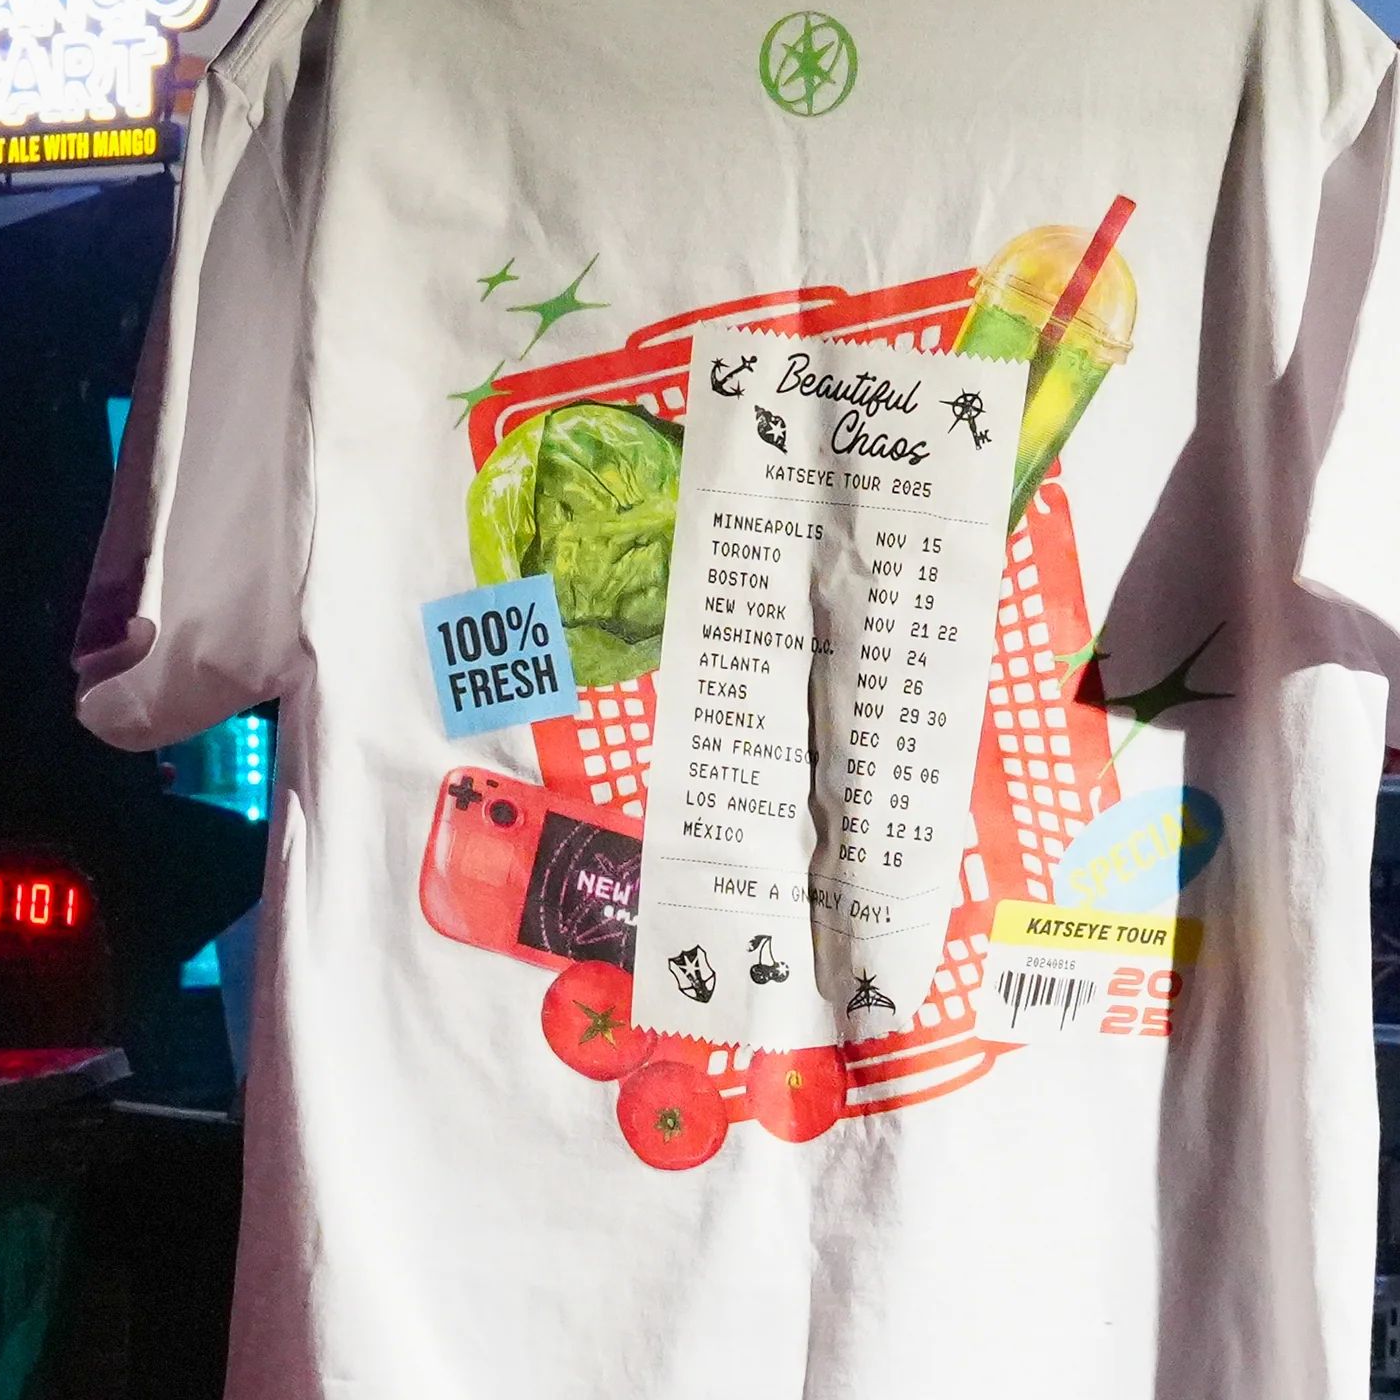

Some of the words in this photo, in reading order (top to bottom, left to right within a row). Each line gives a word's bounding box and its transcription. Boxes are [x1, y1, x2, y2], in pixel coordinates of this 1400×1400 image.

[8, 136, 41, 164] ALE
[43, 131, 90, 161] WITH
[92, 127, 157, 159] MANGO
[776, 352, 922, 417] Beautiful
[831, 409, 930, 465] Chaos
[765, 464, 835, 487] KATSEYE
[843, 472, 881, 491] TOUR
[892, 478, 933, 498] 2025
[713, 512, 824, 540] MINNEAPOLIS
[712, 540, 781, 563] TORONTO
[875, 531, 907, 549] NOV
[922, 537, 942, 554] 15
[708, 568, 769, 590] BOSTON
[872, 560, 903, 577] NOV
[918, 565, 938, 582] 18
[705, 596, 736, 614] NEW
[747, 601, 787, 620] YORK
[868, 588, 899, 605] NOV
[914, 594, 934, 610] 19
[436, 602, 550, 667] 100%
[702, 624, 805, 651] WASHINGTON
[864, 616, 895, 633] NOV
[910, 622, 929, 639] 21
[937, 625, 958, 642] 22
[699, 652, 770, 674] ATLANTA
[860, 644, 892, 662] NOV
[907, 650, 927, 668] 24
[448, 653, 560, 714] FRESH
[698, 679, 748, 700] TEXAS
[857, 673, 888, 690] NOV
[903, 678, 924, 696] 26
[694, 707, 766, 730] PHOENIX
[853, 701, 884, 719] NOV
[900, 707, 920, 724] 29
[927, 710, 947, 727] 30
[691, 735, 722, 752] SAN
[850, 729, 880, 748] DEC
[896, 736, 916, 753] 03
[689, 762, 761, 786] SEATTLE
[847, 758, 876, 777] DEC
[893, 764, 913, 781] 05
[920, 768, 940, 784] 06
[686, 790, 717, 808] LOS
[727, 796, 797, 819] ANGELES
[844, 787, 873, 806] DEC
[890, 793, 910, 810] 09
[683, 817, 744, 843] MÉXICO
[841, 816, 870, 835] DEC
[886, 822, 906, 839] 12
[913, 825, 934, 842] 13
[838, 844, 867, 863] DEC
[883, 851, 903, 868] 16
[577, 869, 631, 906] NEW
[713, 876, 758, 898] HAVE
[769, 883, 779, 900] A
[850, 899, 891, 924] DAY!
[1026, 917, 1112, 941] KATSEYE
[1116, 925, 1168, 946] TOUR
[1025, 956, 1076, 971] 20240816
[1107, 966, 1183, 1001] 20
[1099, 1004, 1173, 1037] 25
